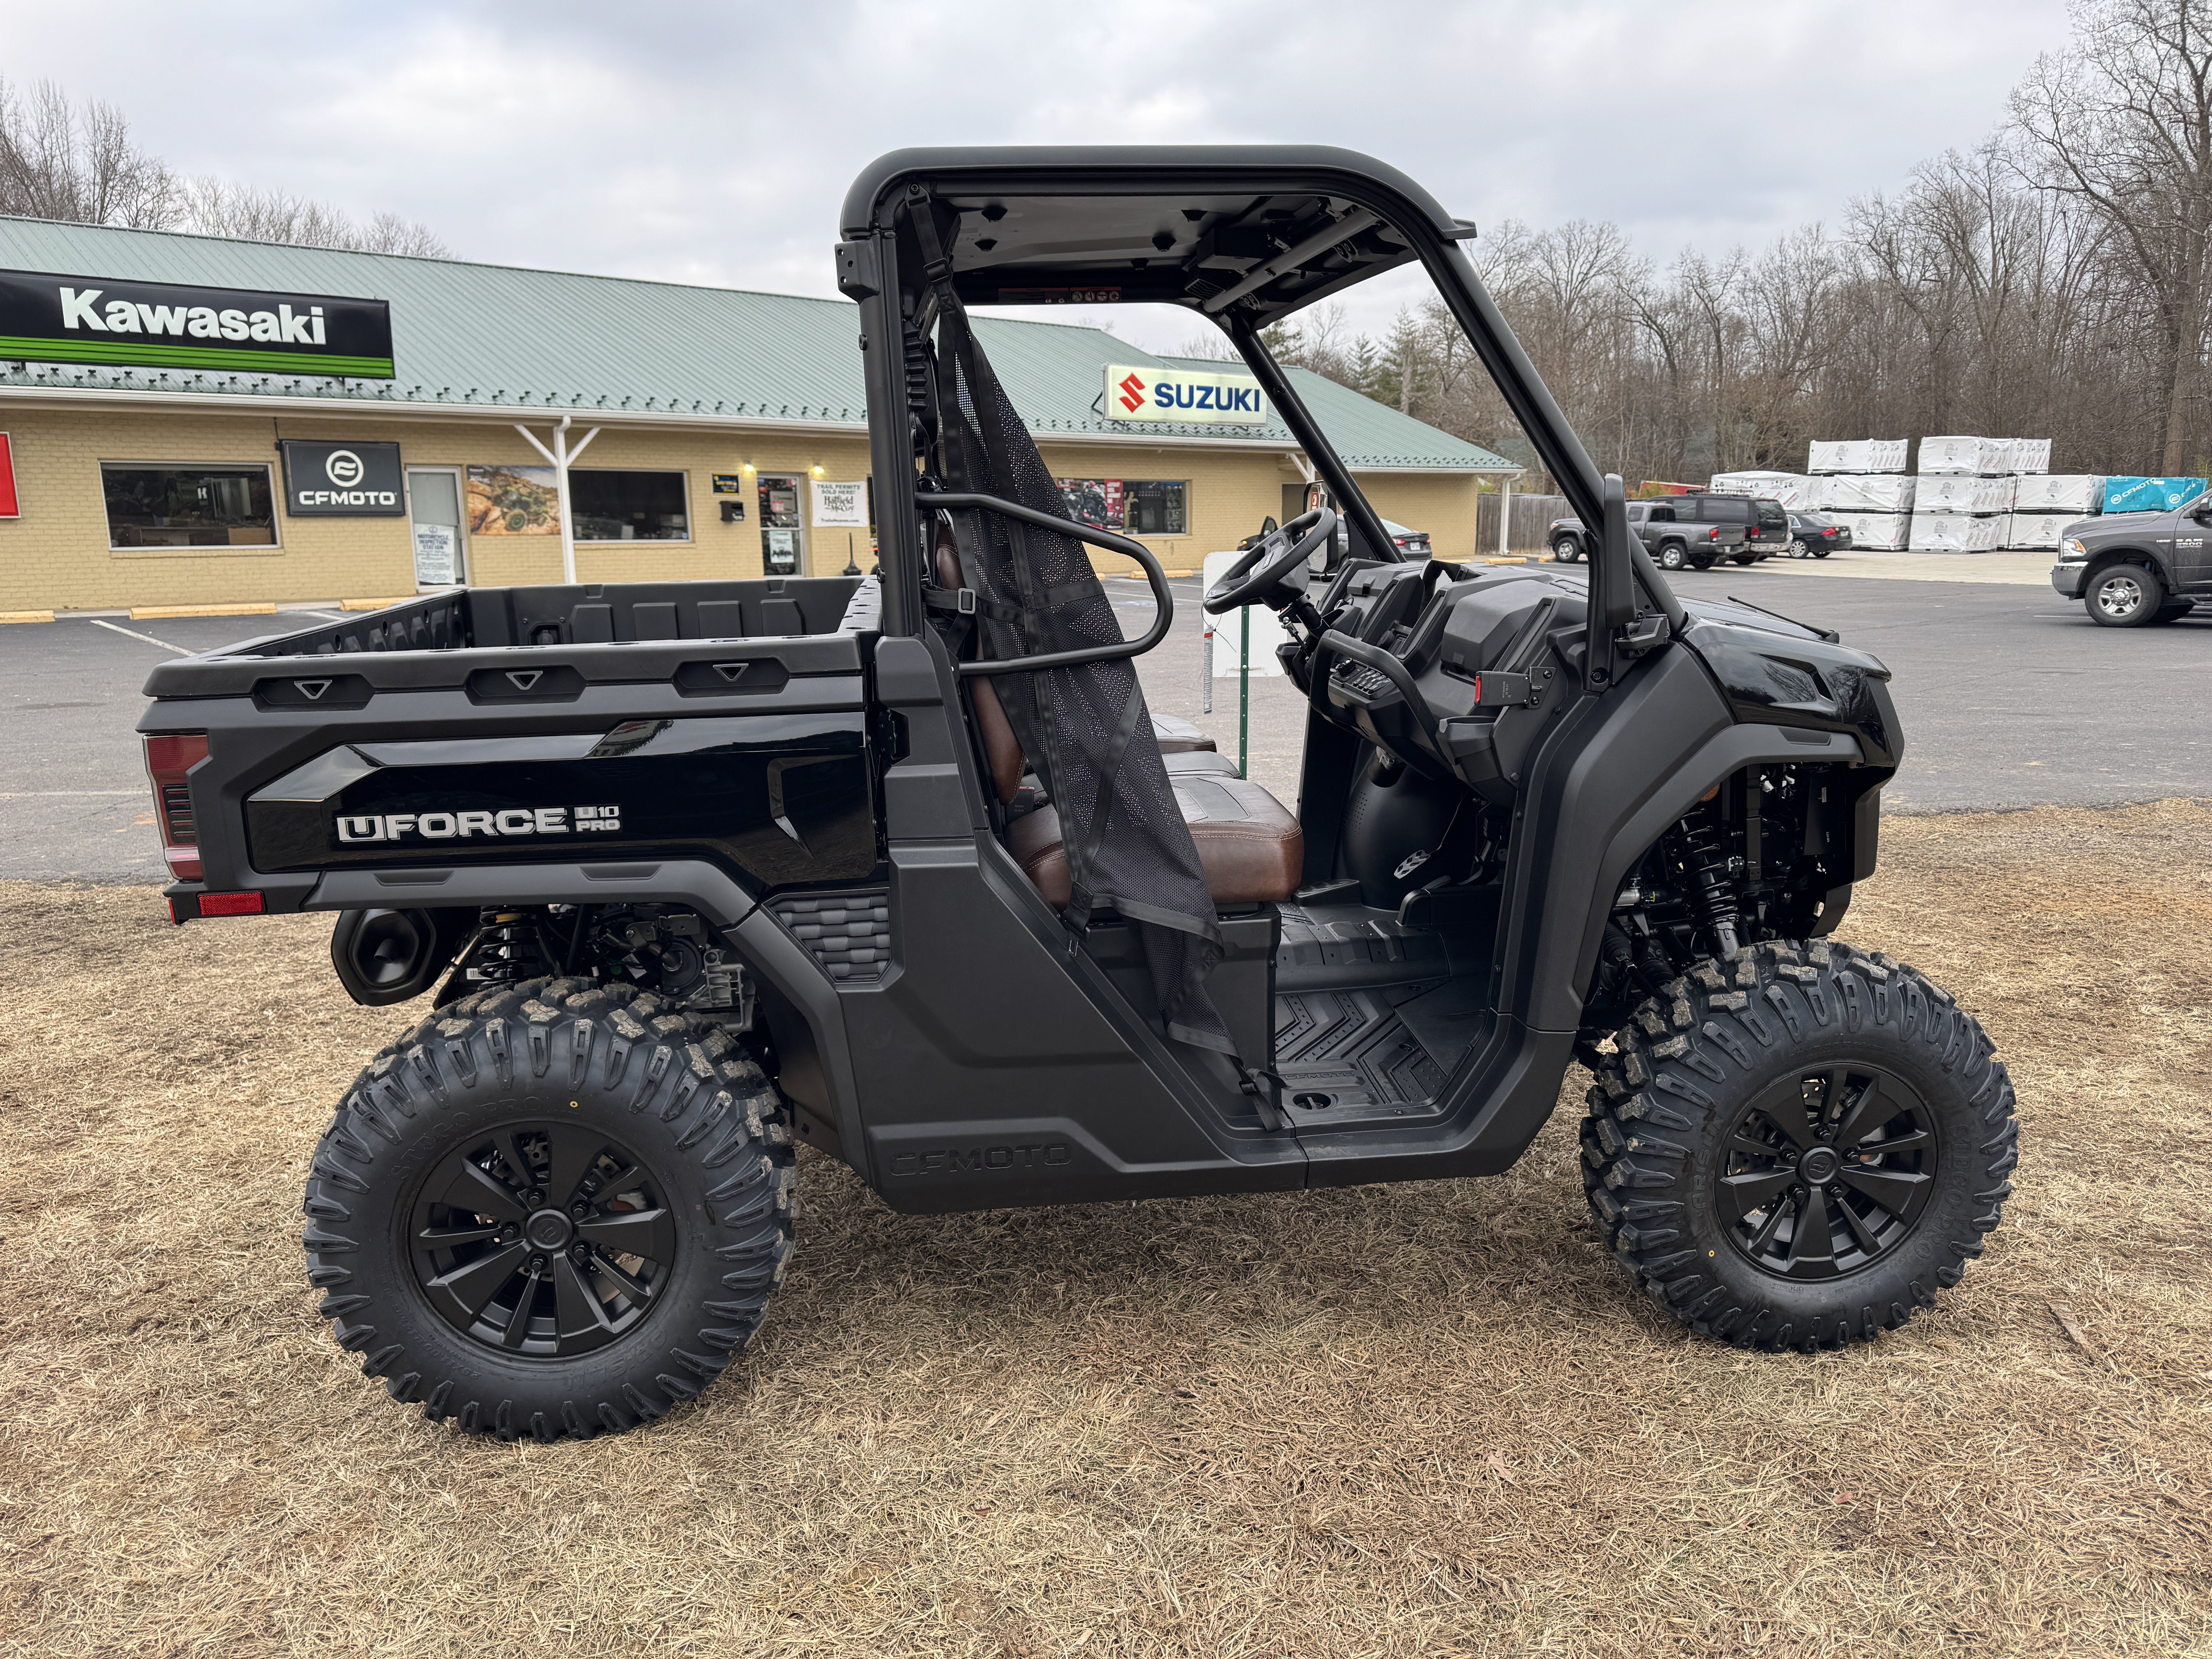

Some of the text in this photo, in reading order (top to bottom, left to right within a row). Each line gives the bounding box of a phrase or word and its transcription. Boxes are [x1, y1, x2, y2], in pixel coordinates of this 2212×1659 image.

[59, 287, 326, 345] Kawasaki
[1154, 382, 1260, 412] SUZUKI
[299, 490, 395, 506] CFMOTO
[576, 819, 620, 832] PRO
[1284, 1071, 1355, 1080] CFMOTO
[890, 1142, 1072, 1176] CFMOTO
[1945, 1124, 1972, 1207] STEGO
